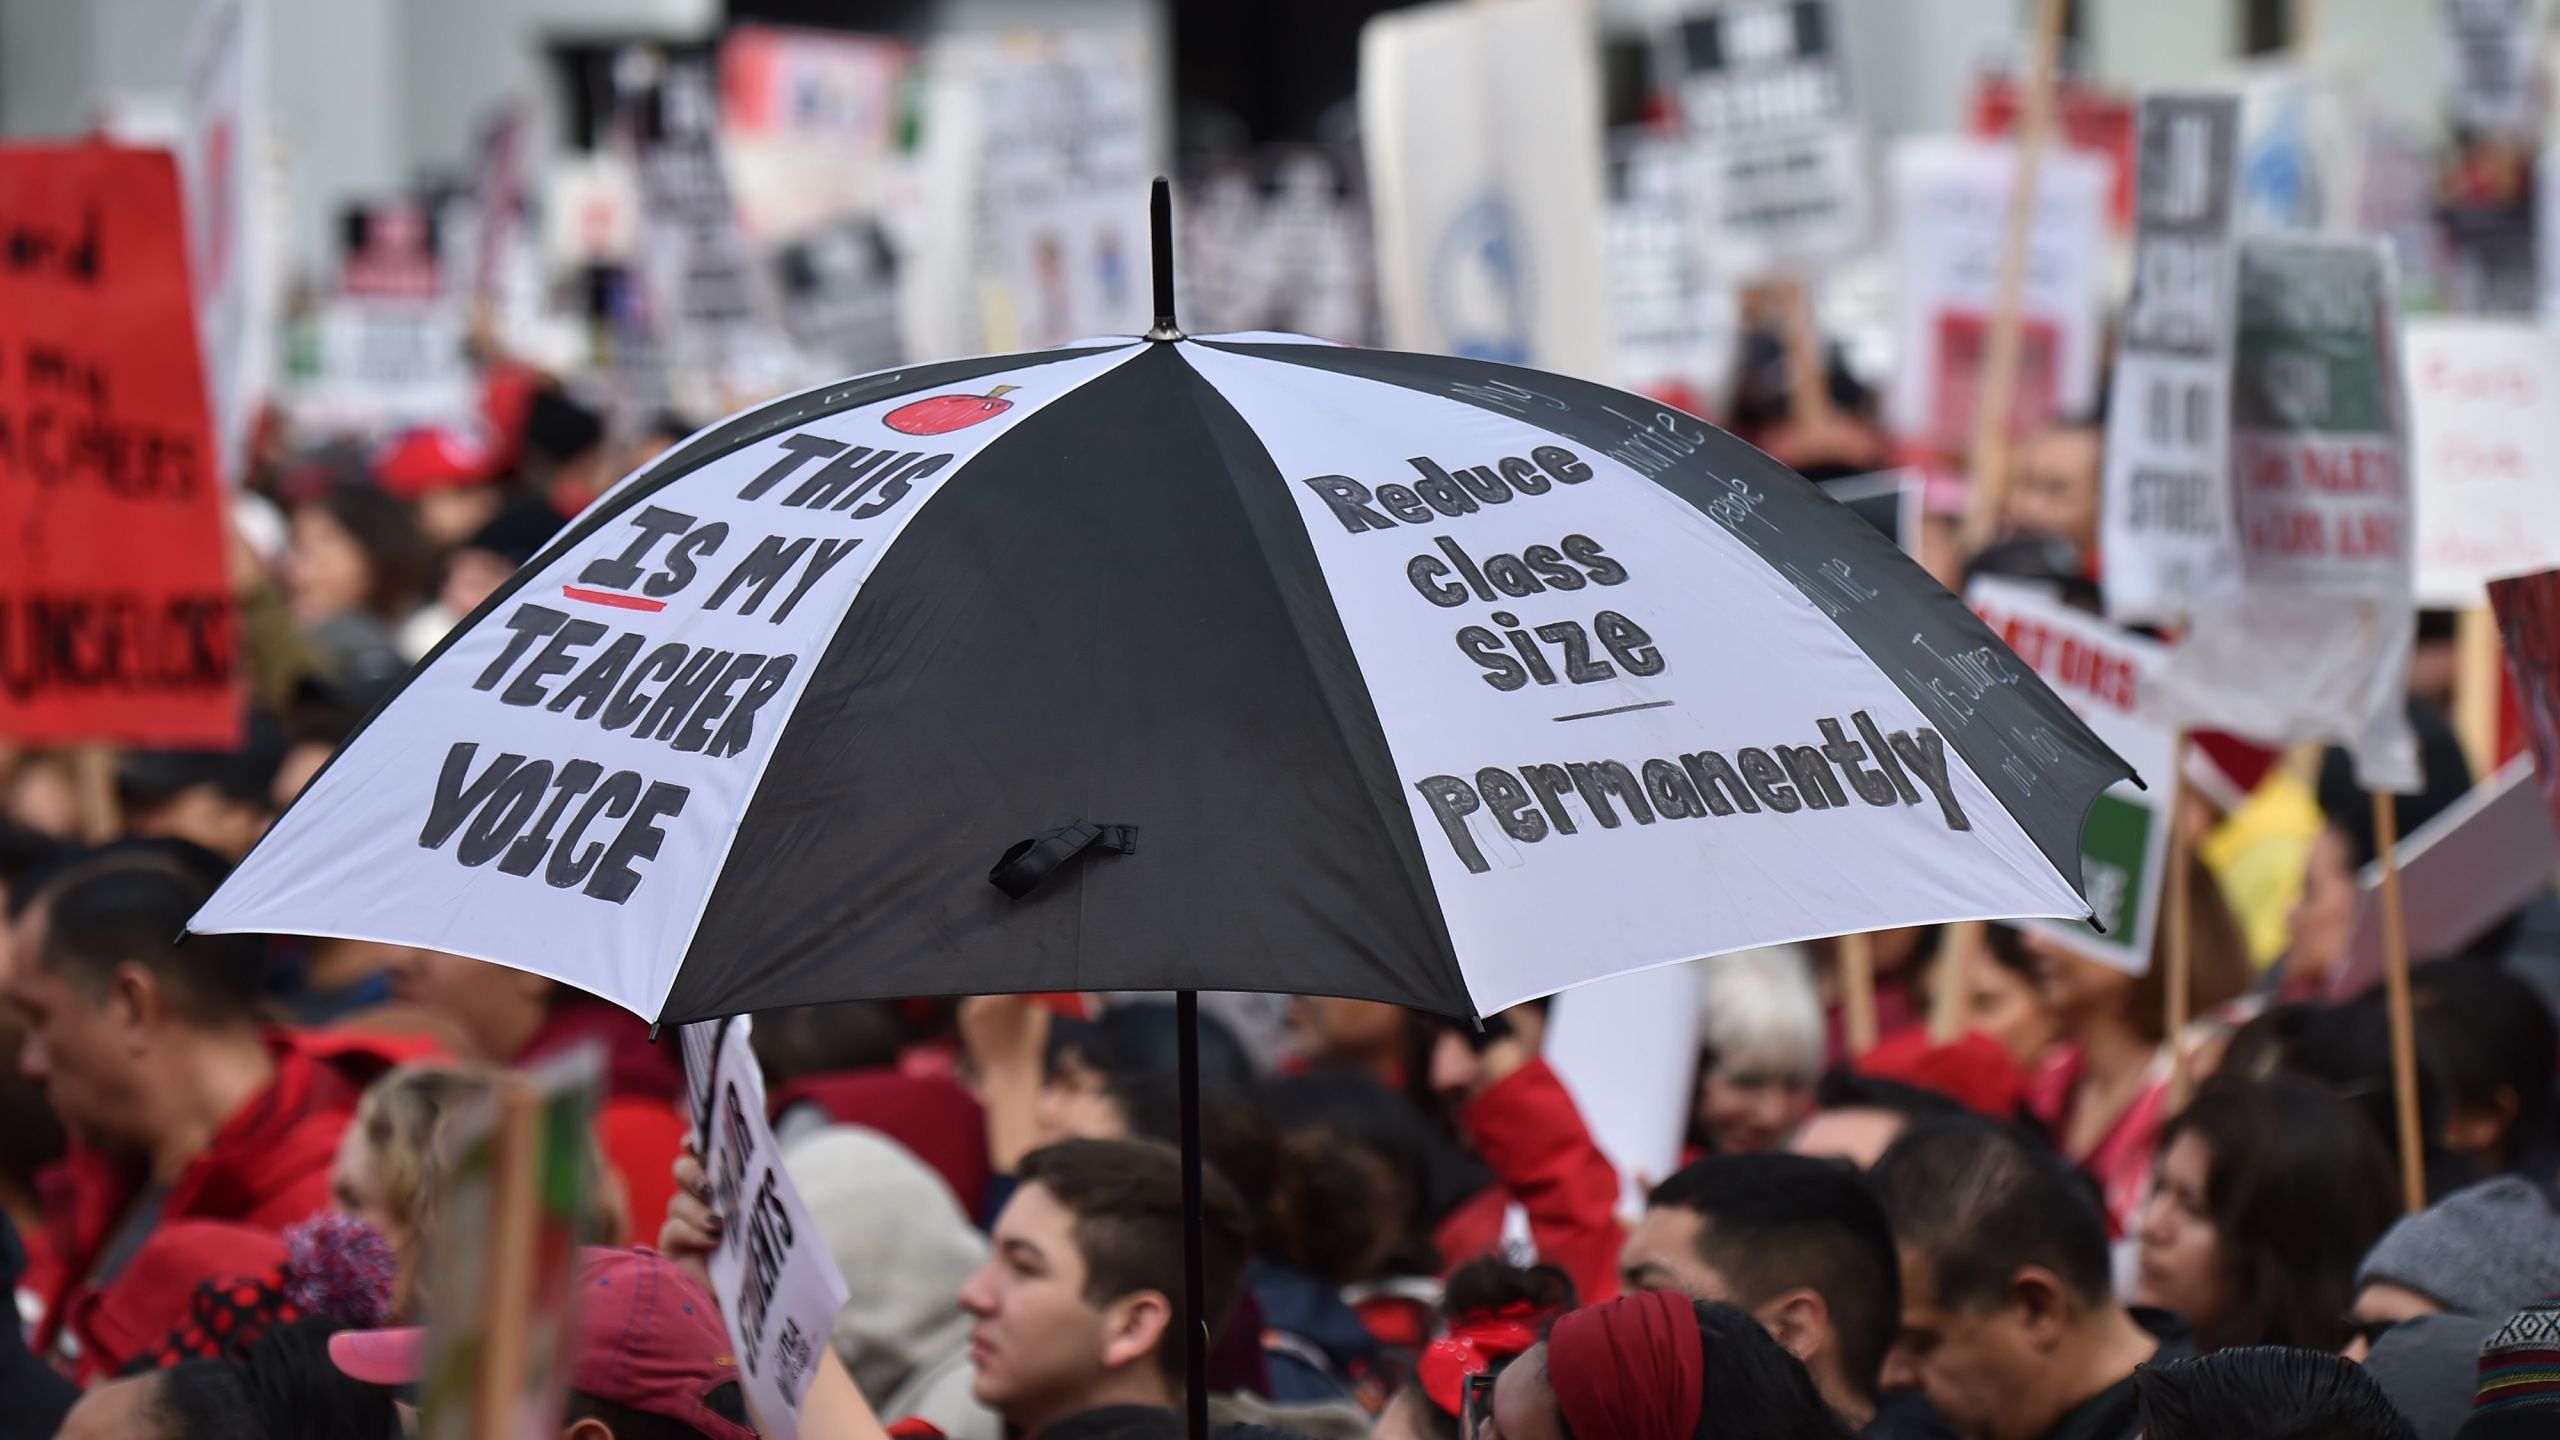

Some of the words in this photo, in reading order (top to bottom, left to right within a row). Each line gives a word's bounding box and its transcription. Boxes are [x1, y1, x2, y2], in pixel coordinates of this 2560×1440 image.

[737, 433, 934, 520] THIS
[1302, 445, 1594, 534] Reduce
[578, 505, 729, 599] IS
[702, 535, 864, 625] MY
[1407, 533, 1631, 608] class
[472, 603, 798, 759] TEACHER
[1456, 610, 1666, 692] size
[418, 741, 691, 905] VOICE
